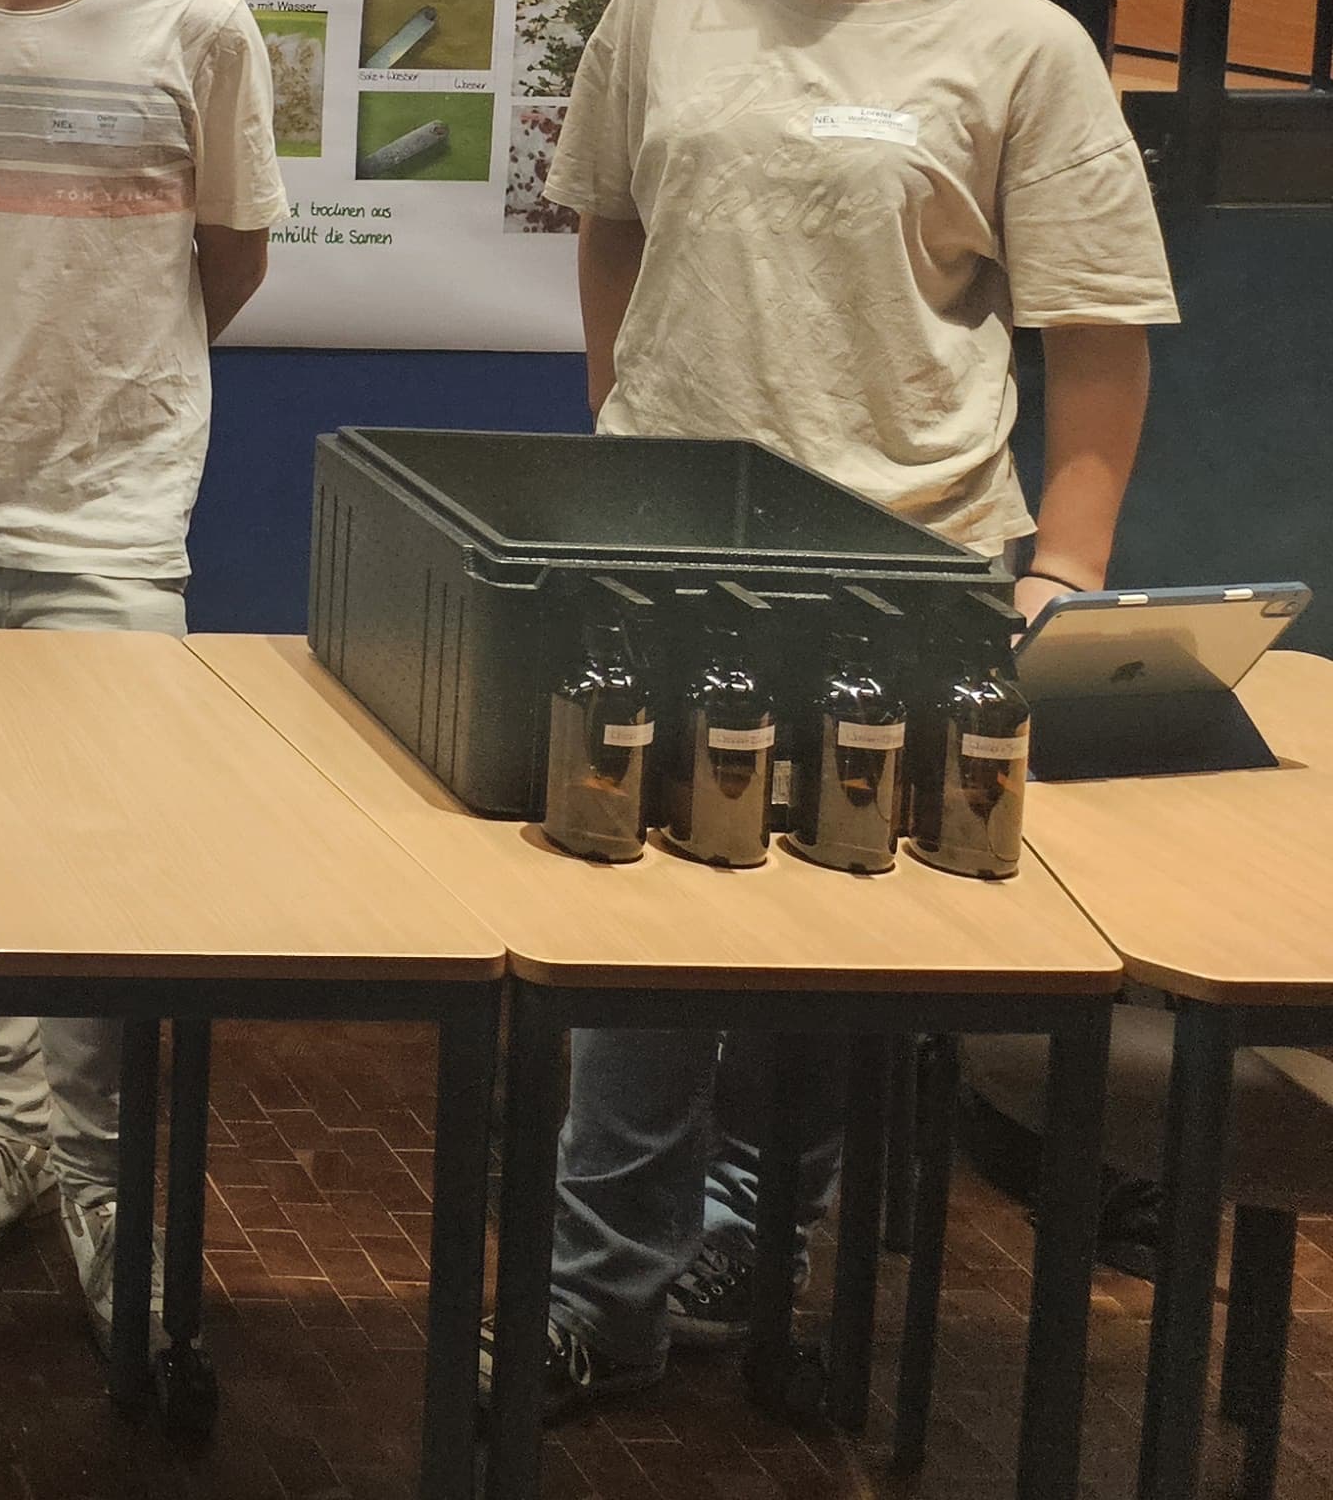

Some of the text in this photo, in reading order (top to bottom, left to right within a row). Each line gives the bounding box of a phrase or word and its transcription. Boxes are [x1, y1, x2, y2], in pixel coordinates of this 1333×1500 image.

[277, 1, 317, 11] Wasser
[371, 206, 392, 219] aus
[271, 225, 393, 245] mhüllt die Samen
